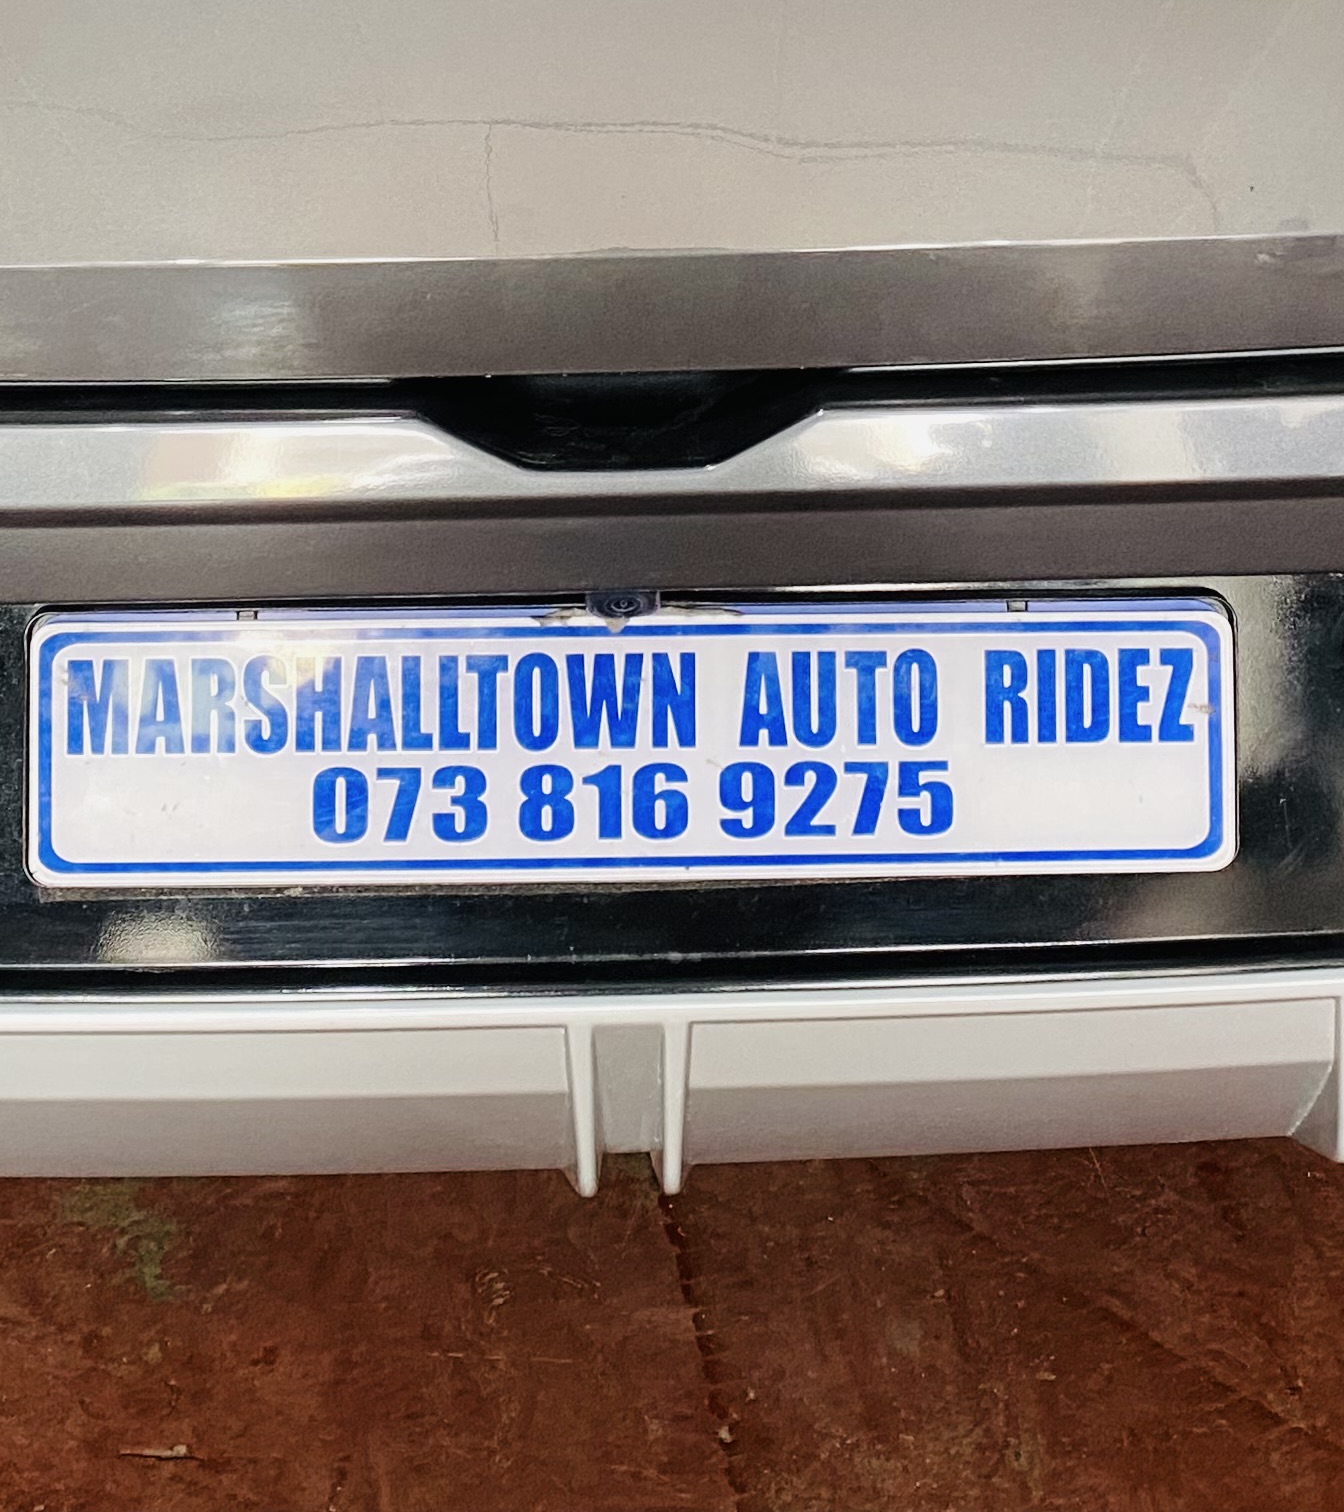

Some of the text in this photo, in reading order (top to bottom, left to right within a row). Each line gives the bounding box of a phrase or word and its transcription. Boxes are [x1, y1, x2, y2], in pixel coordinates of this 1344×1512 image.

[64, 646, 1196, 757] MARSHALLTOWN AUTO RIDEZ
[311, 759, 955, 844] 073 816 9275
